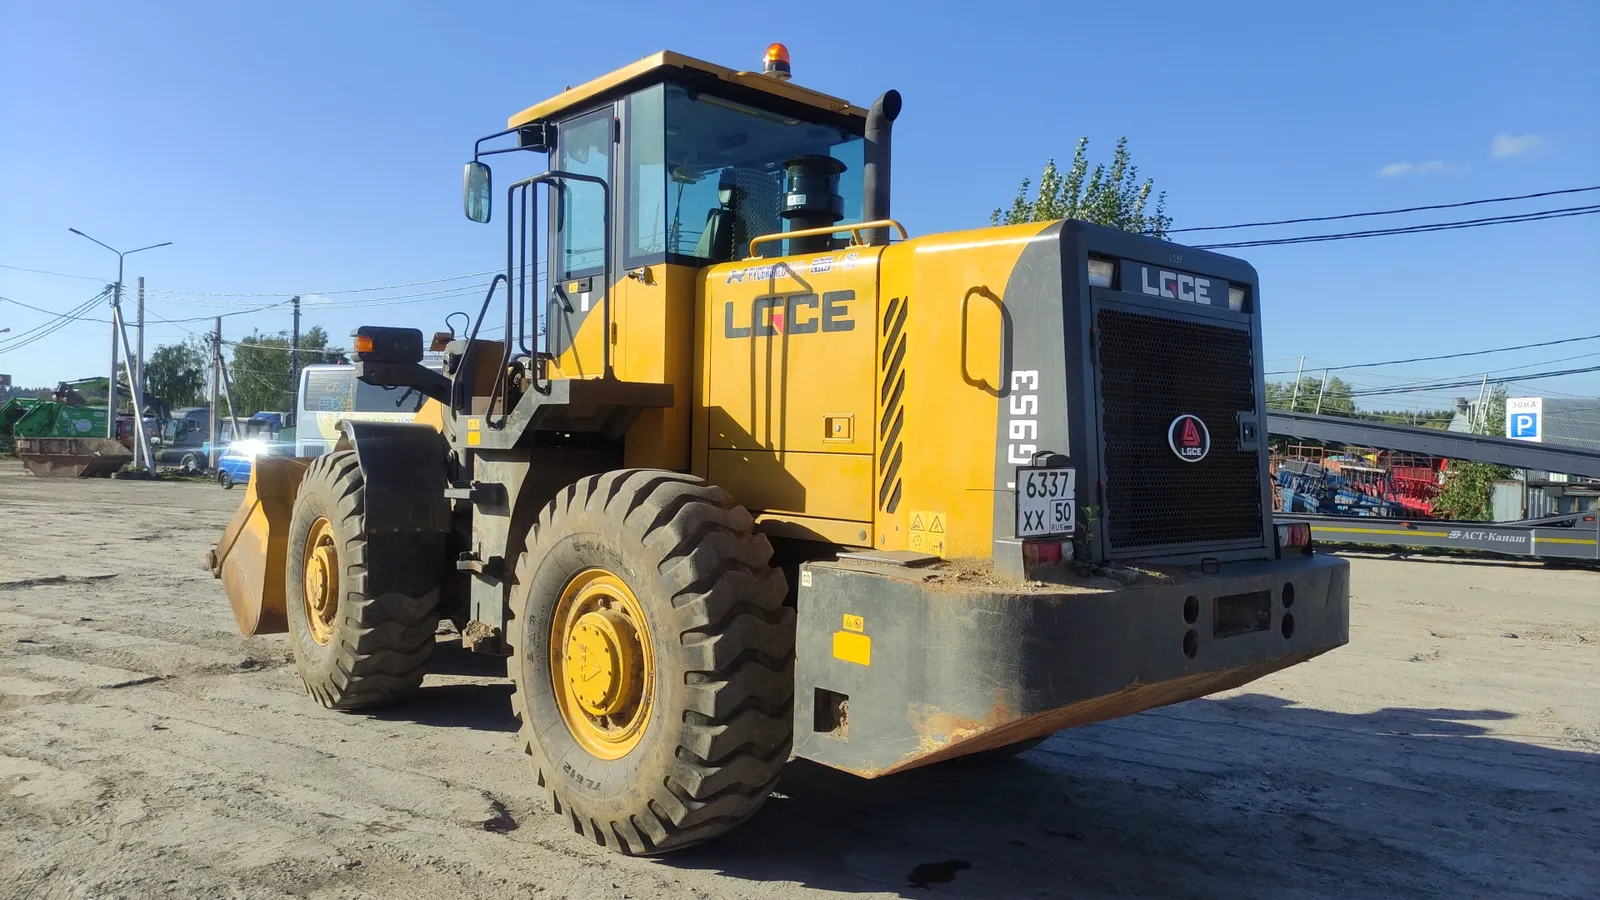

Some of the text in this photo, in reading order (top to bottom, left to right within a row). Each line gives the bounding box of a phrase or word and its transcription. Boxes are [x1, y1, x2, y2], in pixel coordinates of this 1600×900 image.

[1007, 369, 1039, 489] G953
[1181, 447, 1202, 456] LGCE
[1026, 471, 1069, 498] 6337
[1055, 502, 1071, 523] 50
[1051, 523, 1064, 532] RUS
[1462, 531, 1526, 543] АСТ-Канаш
